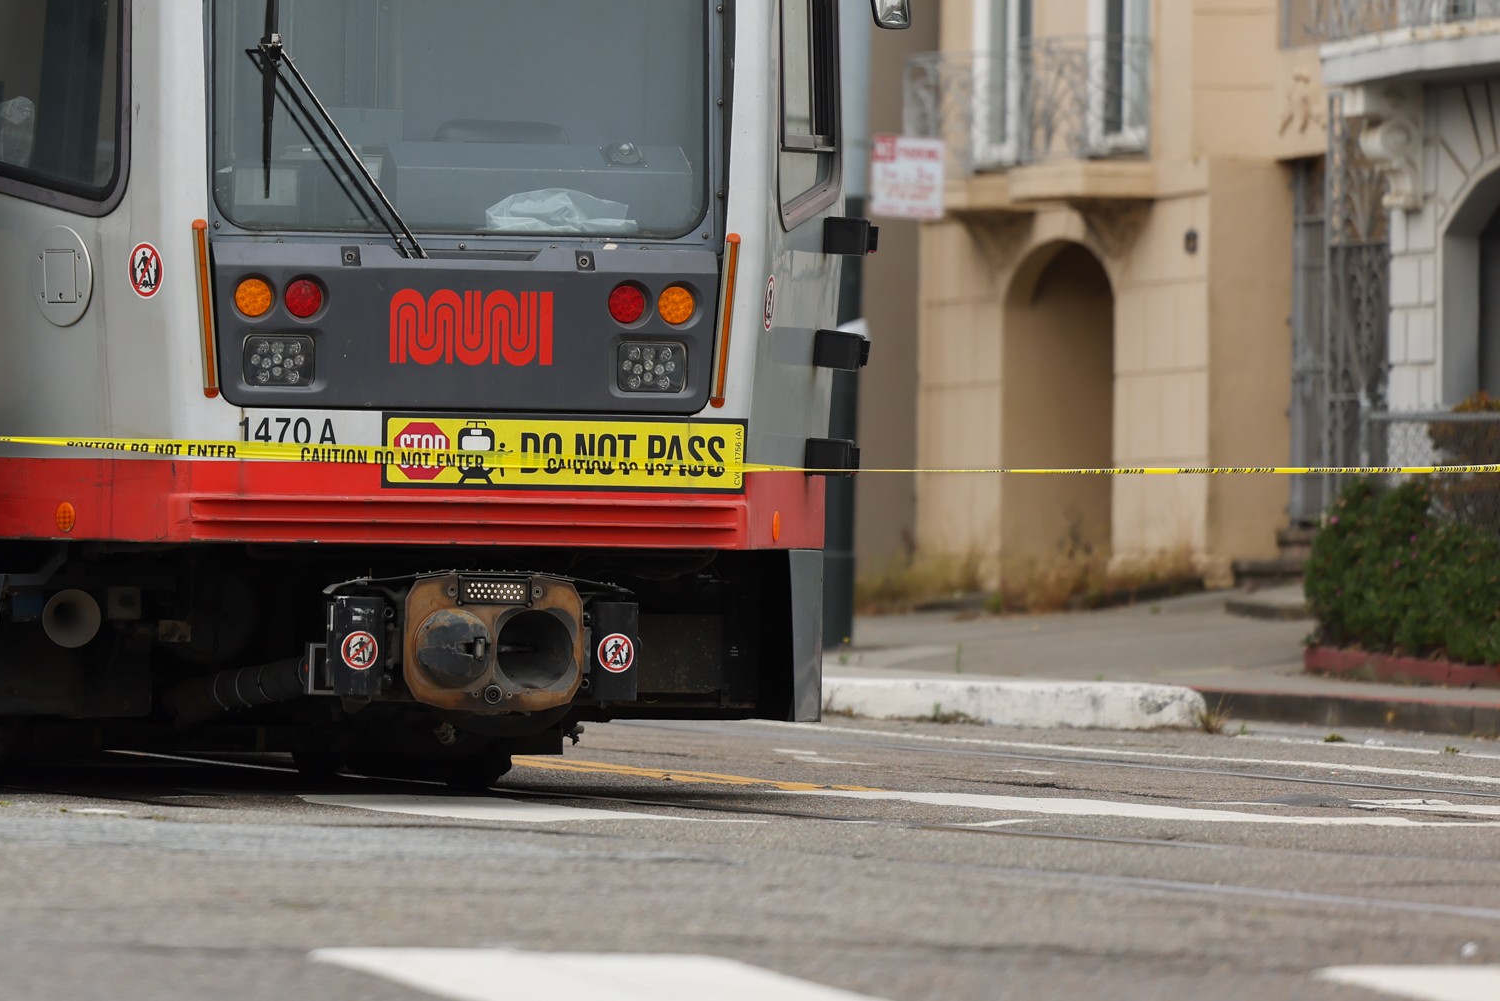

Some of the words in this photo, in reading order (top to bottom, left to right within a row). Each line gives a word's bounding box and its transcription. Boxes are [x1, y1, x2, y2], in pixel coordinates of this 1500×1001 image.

[239, 416, 311, 447] 1470
[319, 418, 337, 447] A
[301, 447, 368, 464] CAUTION
[374, 450, 395, 465] DO
[401, 451, 431, 466] NOT
[436, 453, 485, 468] ENTER
[400, 433, 446, 469] STOP
[521, 432, 563, 474] DO
[575, 433, 637, 476] NOT
[648, 434, 726, 478] PASS
